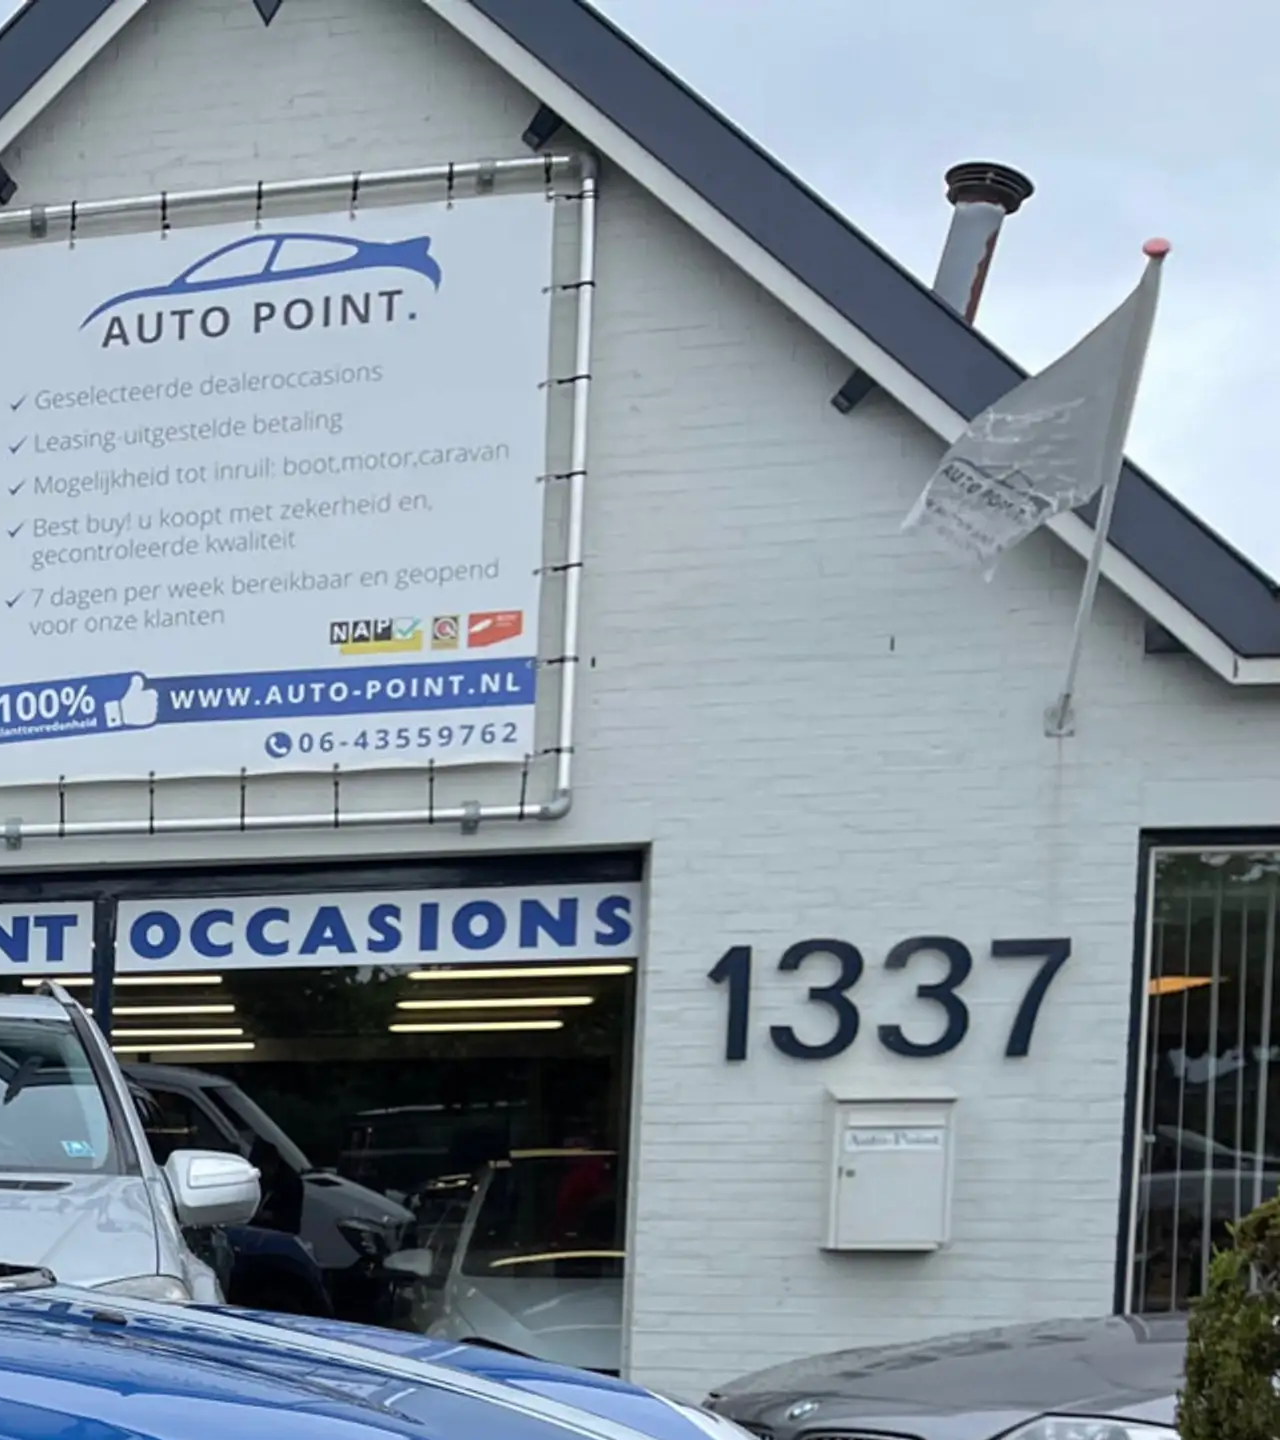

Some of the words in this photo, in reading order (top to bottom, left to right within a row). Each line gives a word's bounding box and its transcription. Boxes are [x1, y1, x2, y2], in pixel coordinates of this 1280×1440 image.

[101, 306, 231, 348] AUTO
[34, 377, 193, 411] Geselecteerde
[200, 364, 384, 396] dealeroccasions
[253, 411, 344, 435] betaling
[34, 465, 170, 498] Mogelijkheid
[176, 466, 207, 485] tot
[213, 456, 276, 481] inruil:
[33, 516, 80, 538] Best
[85, 512, 132, 537] buy!
[138, 514, 152, 530] u
[159, 506, 222, 531] koopt
[229, 504, 273, 524] met
[279, 492, 391, 521] zekerheid
[31, 536, 200, 572] gecontroleerde
[205, 530, 297, 554] kwaliteit
[31, 587, 44, 608] 7
[50, 584, 118, 611] dagen
[123, 583, 161, 606] per
[167, 576, 225, 599] week
[231, 569, 352, 596] bereikbaar
[359, 568, 389, 587] en
[393, 557, 500, 591] geopend
[28, 615, 78, 636] voor
[83, 613, 138, 634] onze
[143, 607, 226, 630] klanten
[331, 617, 392, 645] NAP
[169, 671, 522, 709] WWW.AUTO-POINT.NL
[298, 721, 518, 753] 06-43559762
[129, 896, 634, 960] OCCASIONS
[706, 935, 1073, 1062] 1337
